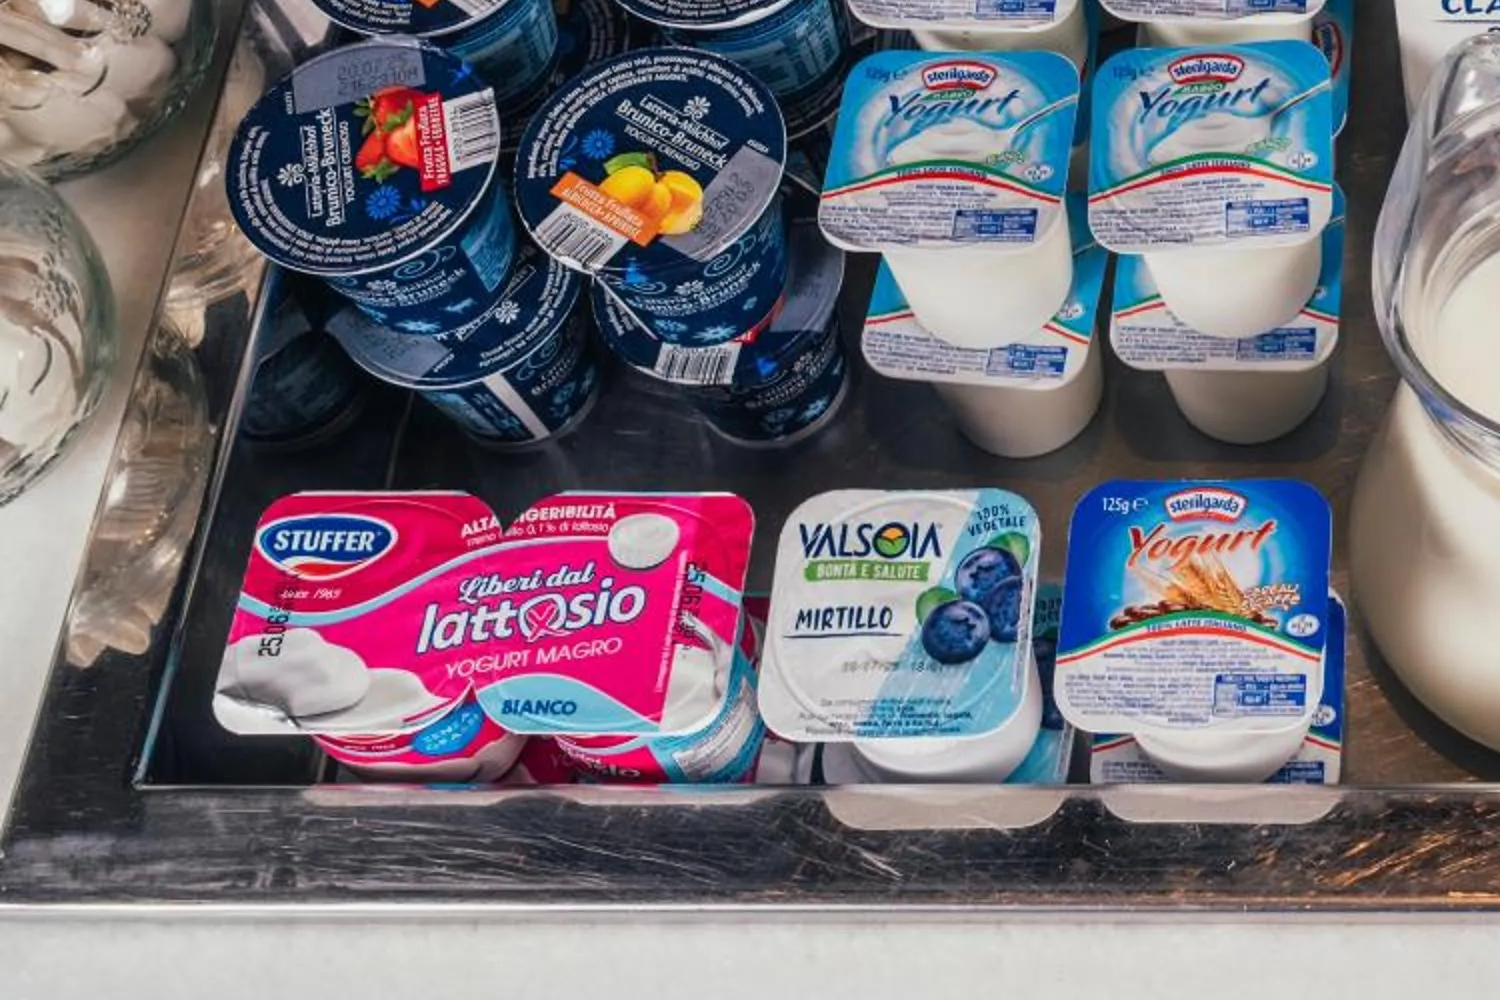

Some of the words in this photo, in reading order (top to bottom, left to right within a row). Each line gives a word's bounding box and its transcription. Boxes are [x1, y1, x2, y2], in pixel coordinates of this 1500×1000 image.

[927, 69, 992, 87] sterilgarda
[1172, 61, 1240, 78] sterilgarda
[889, 89, 1021, 130] Yogurt
[1140, 79, 1270, 125] Yogurt
[616, 99, 728, 169] Brunico-Bruneck
[316, 107, 342, 227] Brunico-Bruneck
[976, 504, 1010, 520] 100%
[1103, 498, 1130, 514] 125g
[1170, 495, 1240, 514] sterilgarda
[461, 515, 500, 538] ALTA
[967, 516, 1027, 537] VEGETALE
[273, 527, 377, 554] STUFFER
[799, 522, 942, 559] VALSOIA
[1127, 520, 1277, 568] Yogurt
[459, 569, 543, 603] Liberi
[546, 562, 596, 588] dal
[816, 562, 857, 579] BONTÀ
[861, 564, 868, 578] E
[873, 563, 921, 578] SALUTE
[416, 579, 646, 655] lattosio
[794, 604, 893, 631] MIRTILLO
[445, 650, 530, 679] YOGURT
[536, 637, 623, 664] MAGRO
[500, 697, 578, 717] BIANCO
